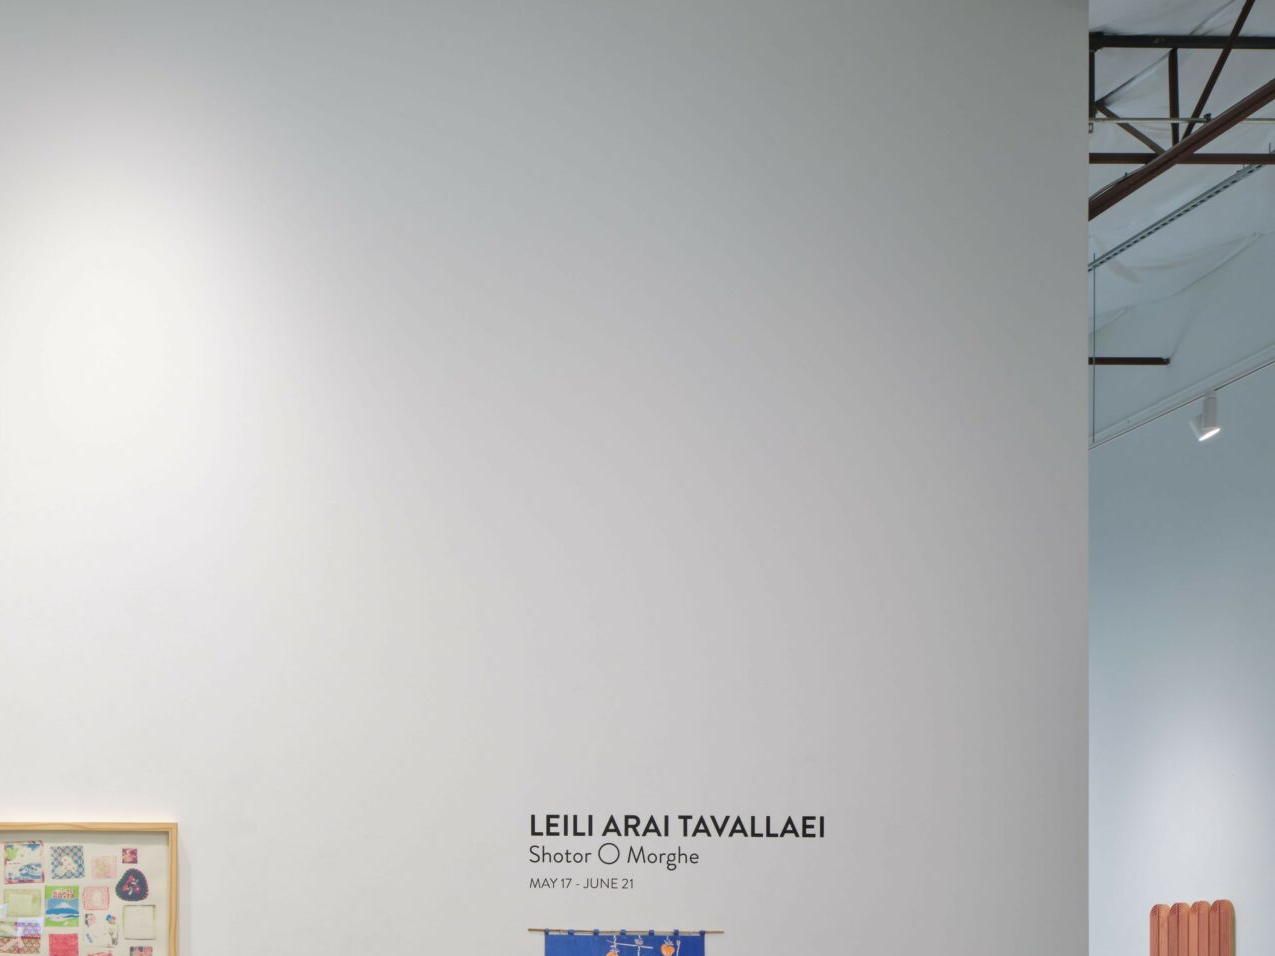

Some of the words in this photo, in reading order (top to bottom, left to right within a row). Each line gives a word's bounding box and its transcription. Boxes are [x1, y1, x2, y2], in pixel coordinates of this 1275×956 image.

[530, 814, 593, 837] LEILI
[601, 814, 669, 837] ARAI
[677, 815, 825, 838] TAVALLAEI
[529, 845, 592, 864] Shotor
[597, 842, 621, 865] O
[627, 845, 700, 871] Morghe
[529, 878, 558, 889] MAY
[560, 878, 572, 889] 17
[583, 878, 618, 889] JUNE
[621, 878, 634, 889] 21
